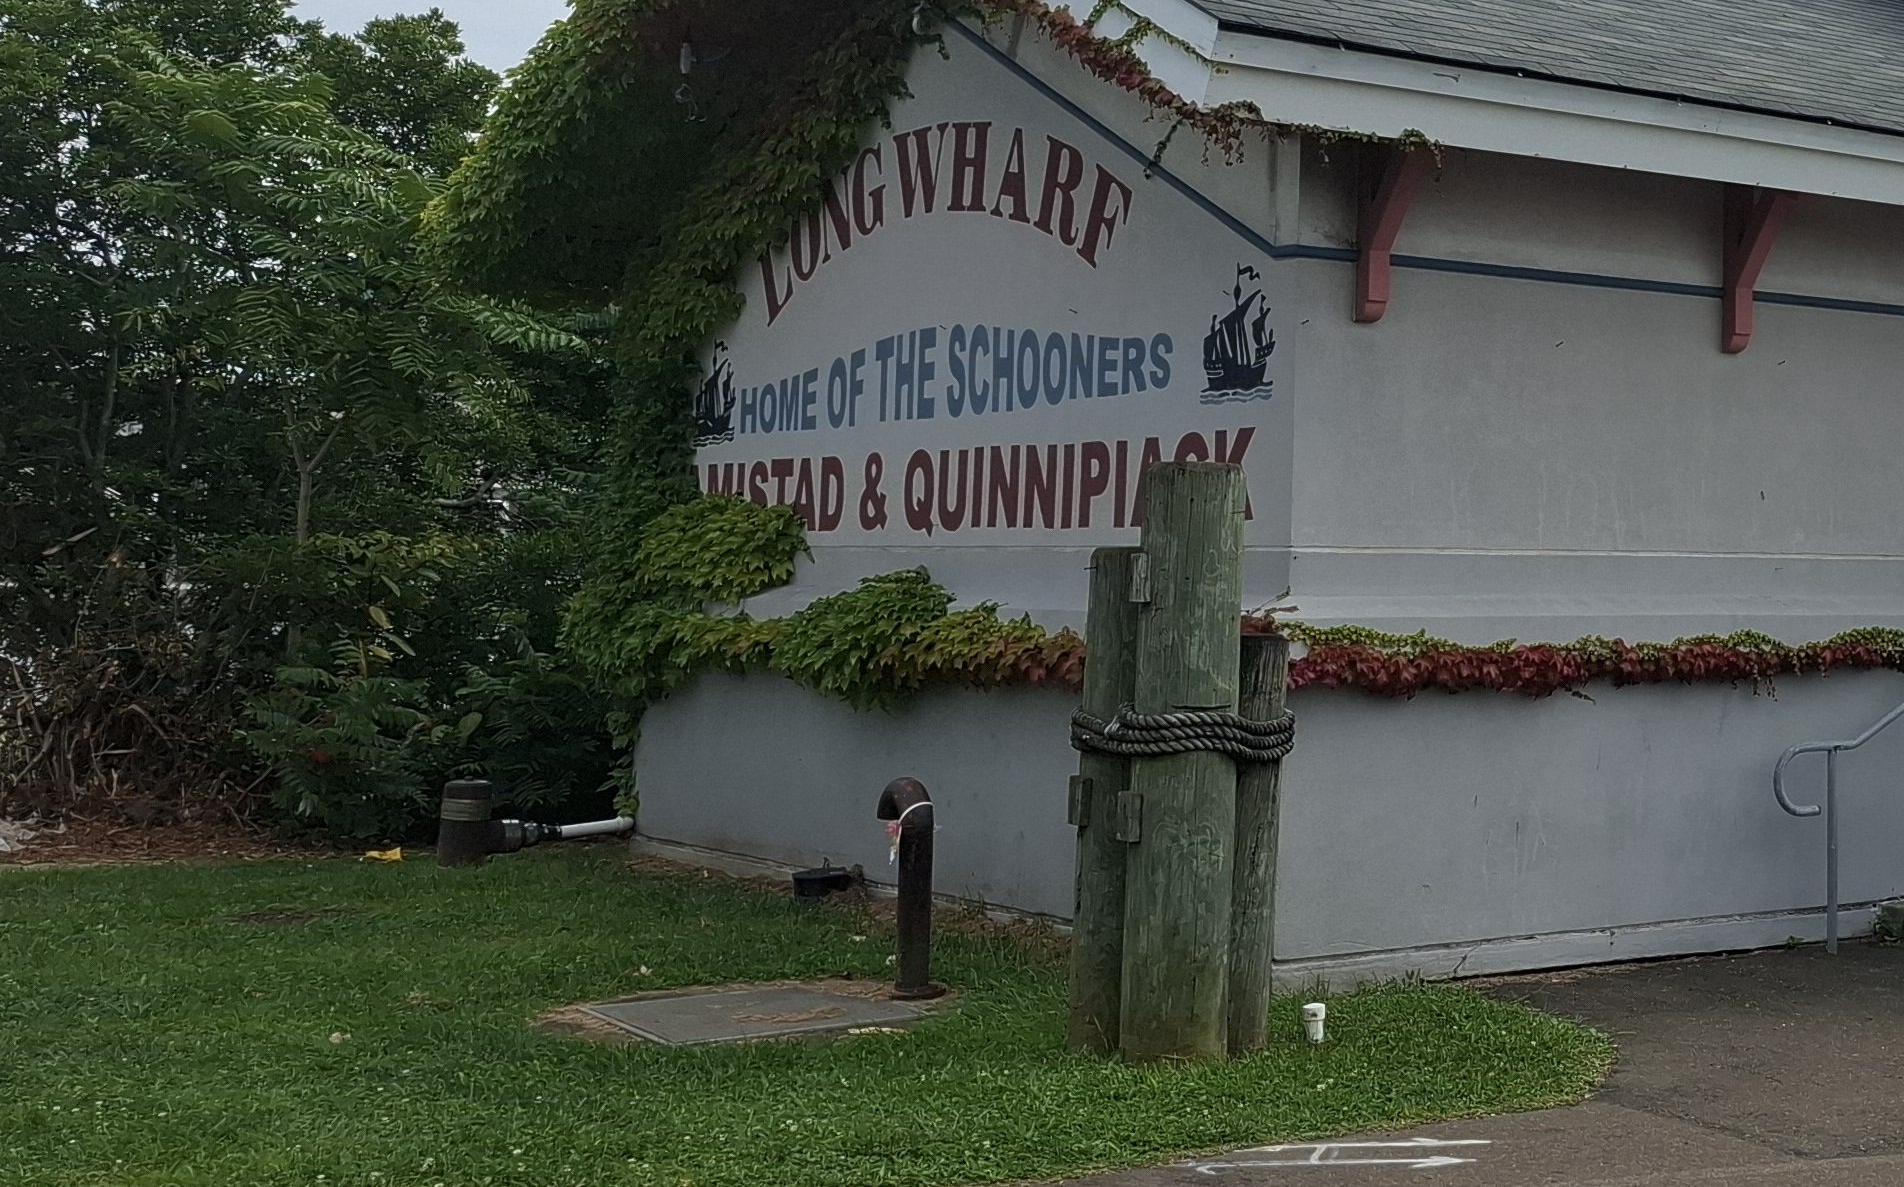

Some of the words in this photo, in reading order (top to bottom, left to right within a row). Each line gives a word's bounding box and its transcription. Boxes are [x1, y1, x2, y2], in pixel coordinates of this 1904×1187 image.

[757, 141, 886, 327] LONG
[893, 120, 1134, 269] WHARF
[739, 369, 818, 432] HOME
[827, 348, 867, 429] OF
[875, 325, 938, 422] THE
[946, 323, 1175, 418] SCHOONERS
[858, 451, 888, 532] &
